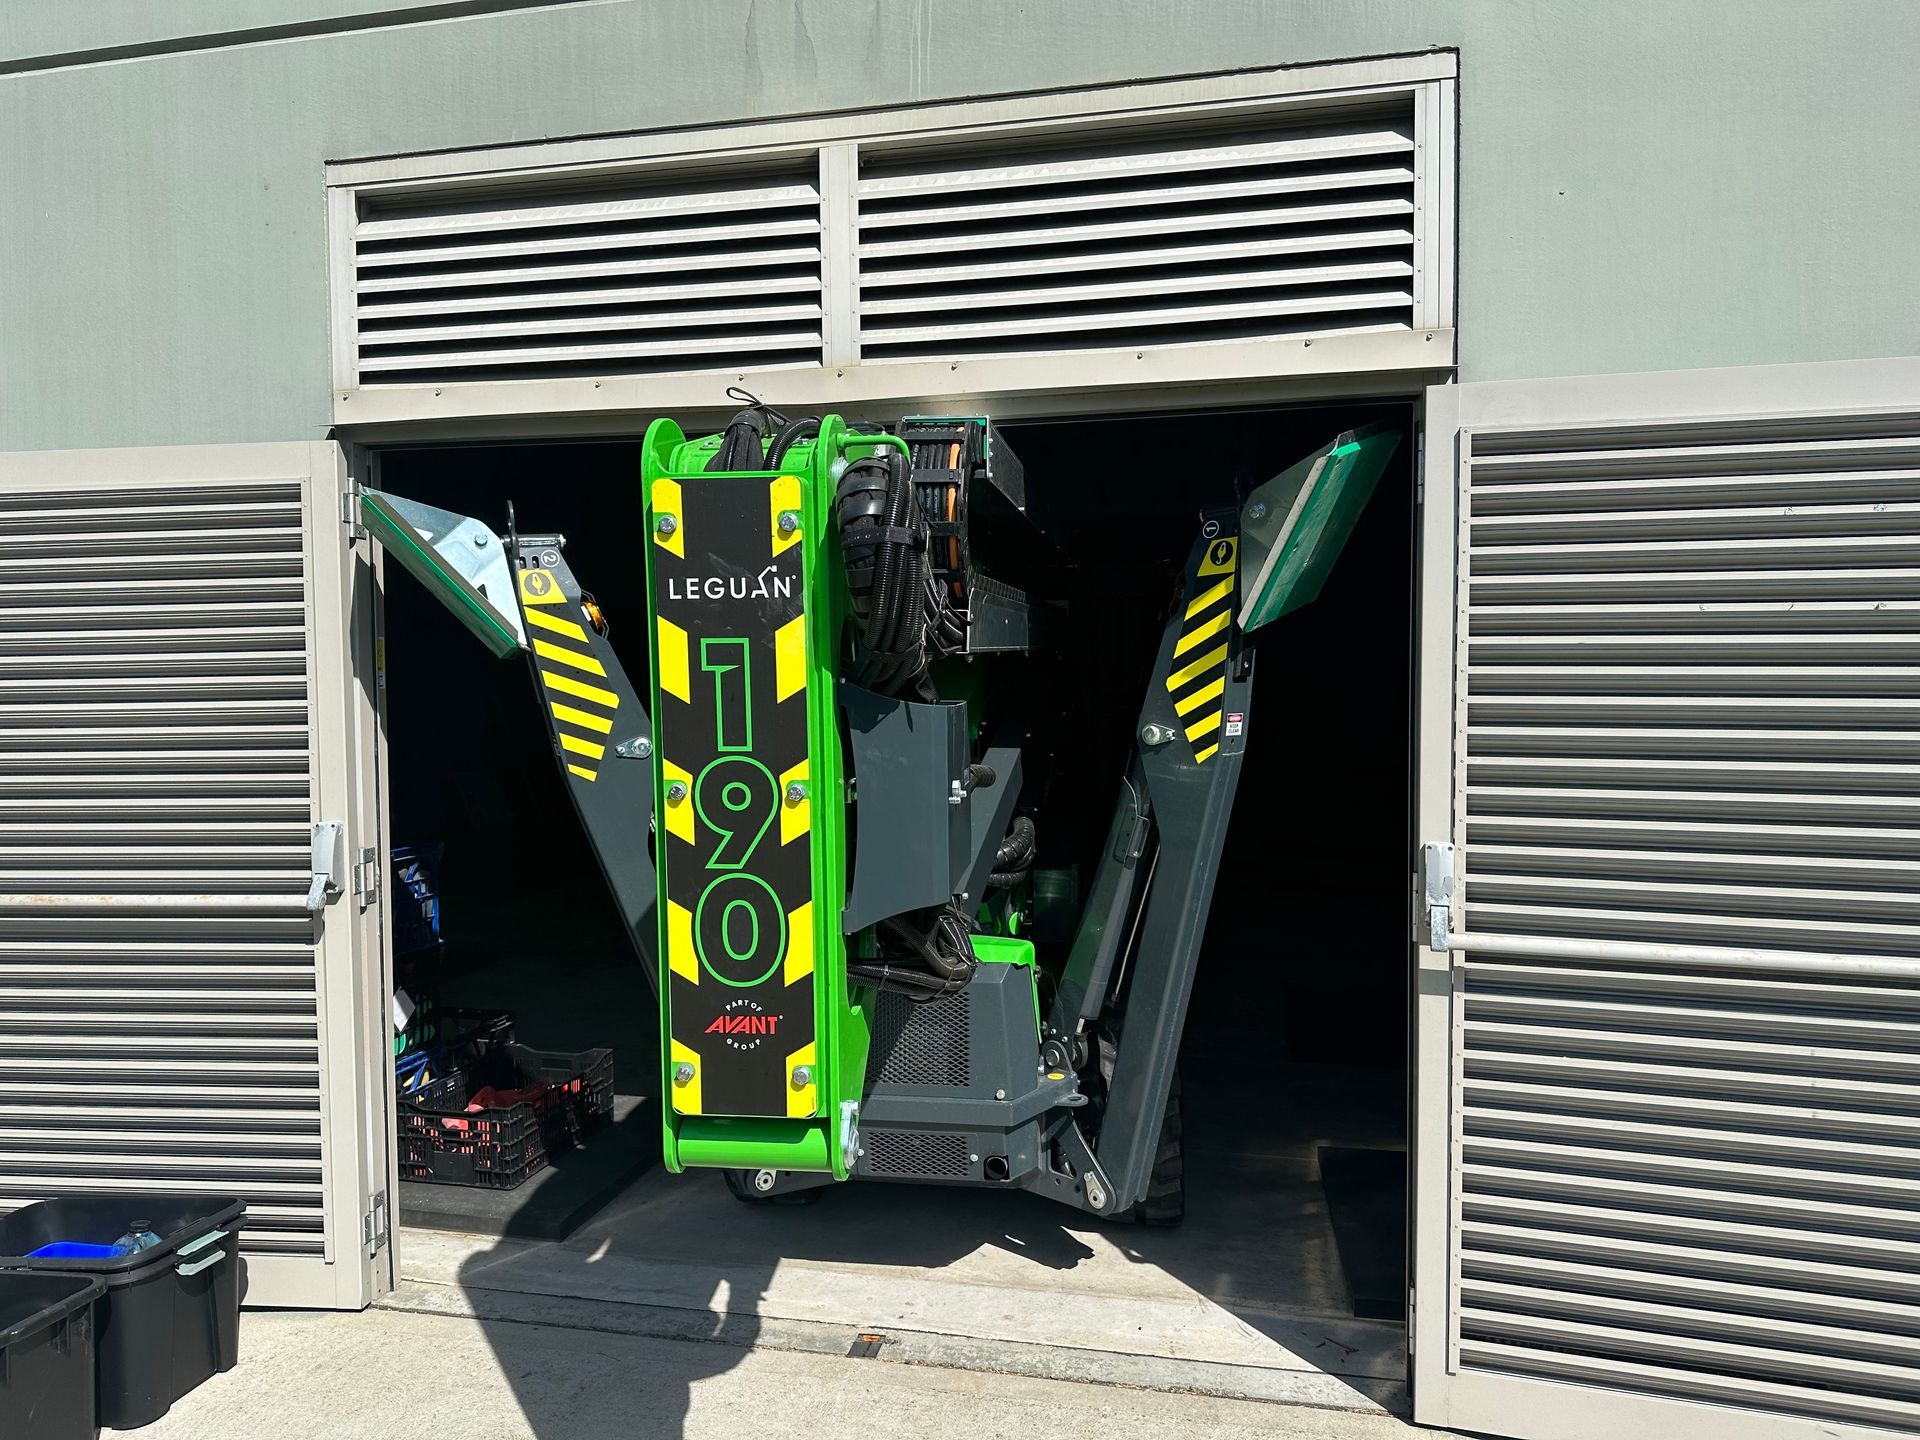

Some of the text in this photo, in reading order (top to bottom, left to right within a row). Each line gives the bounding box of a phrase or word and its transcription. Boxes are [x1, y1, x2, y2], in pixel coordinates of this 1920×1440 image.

[668, 565, 791, 600] LEGUAN
[694, 637, 786, 988] 190
[725, 999, 763, 1012] PART OF
[704, 1015, 778, 1035] AVANT
[726, 1038, 761, 1051] GROUP
